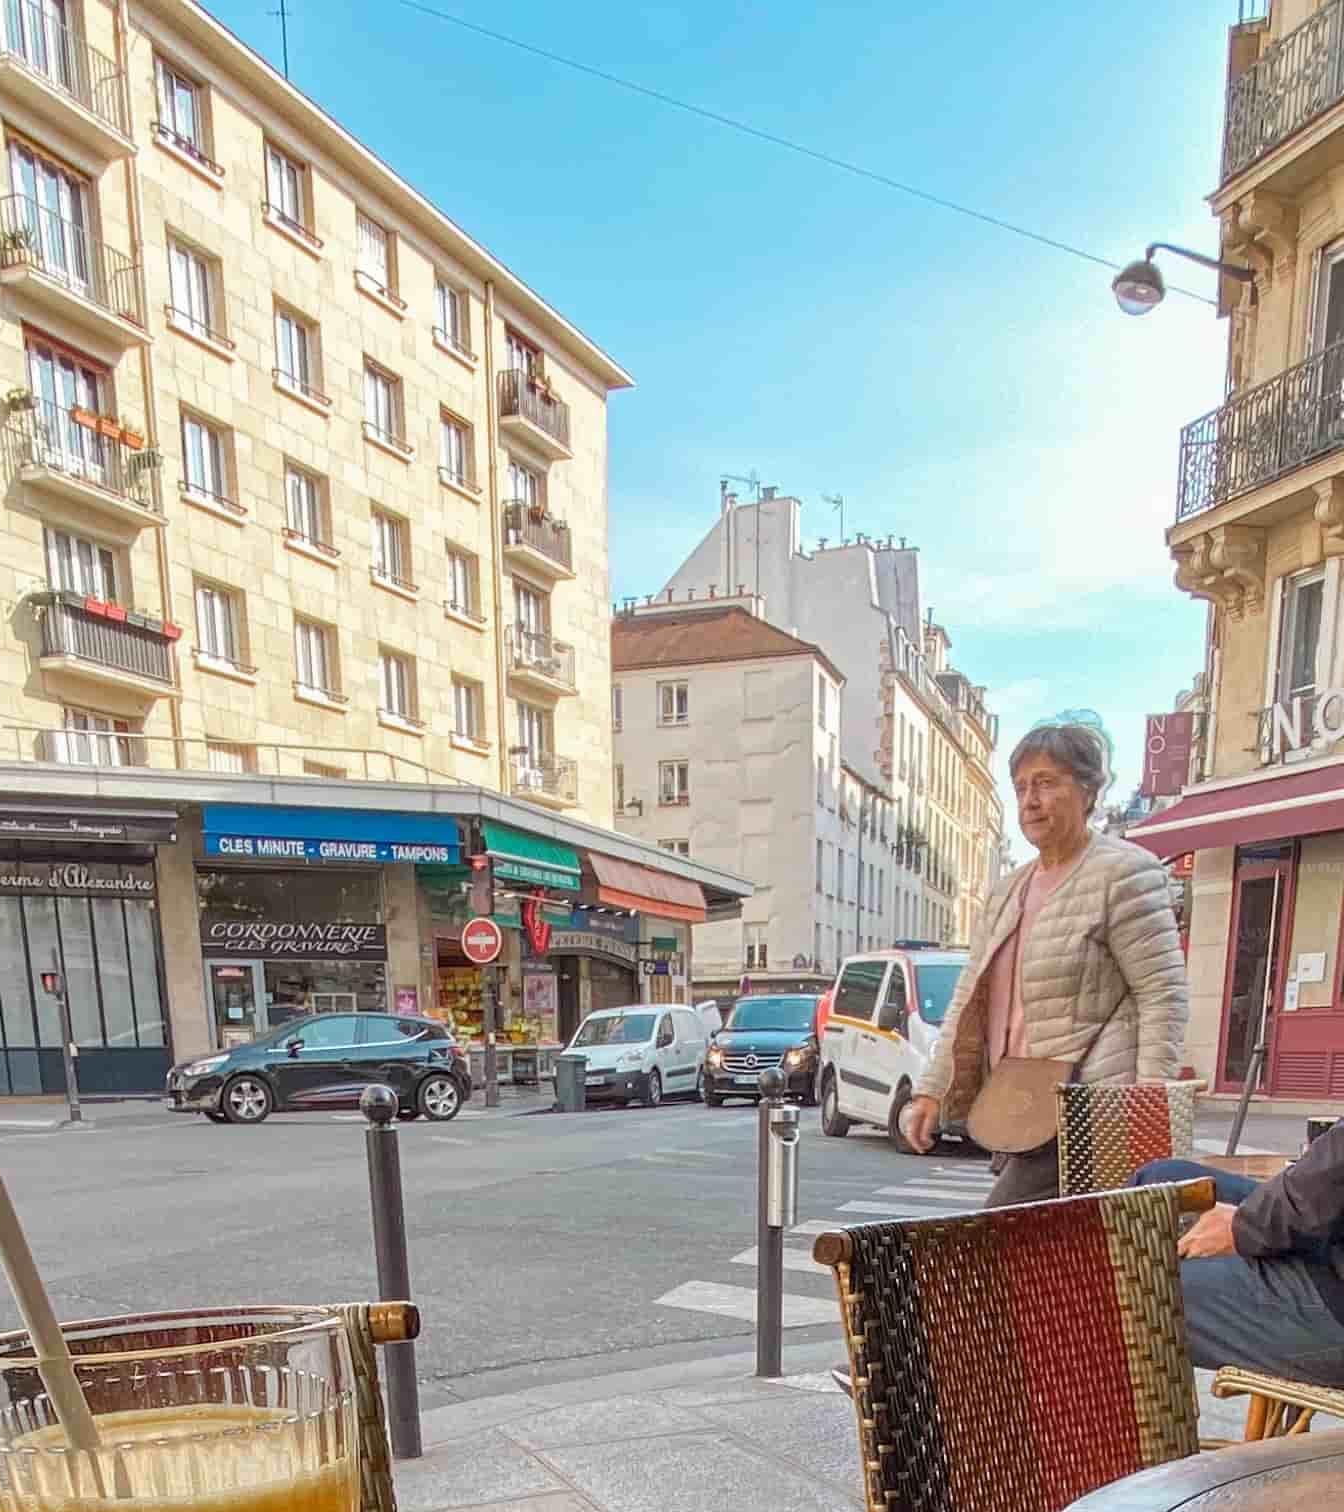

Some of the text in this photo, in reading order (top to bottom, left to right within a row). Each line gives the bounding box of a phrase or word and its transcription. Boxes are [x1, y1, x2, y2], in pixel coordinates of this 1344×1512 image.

[1147, 715, 1167, 793] NOLI
[219, 837, 253, 854] CLES
[258, 840, 305, 856] MINUTE
[320, 842, 377, 859] GRAVURE
[391, 845, 449, 862] TAMPONS
[48, 862, 155, 891] d'Alexandre
[210, 922, 377, 941] CORDONNERIE
[224, 941, 362, 954] CLES GRAVURES
